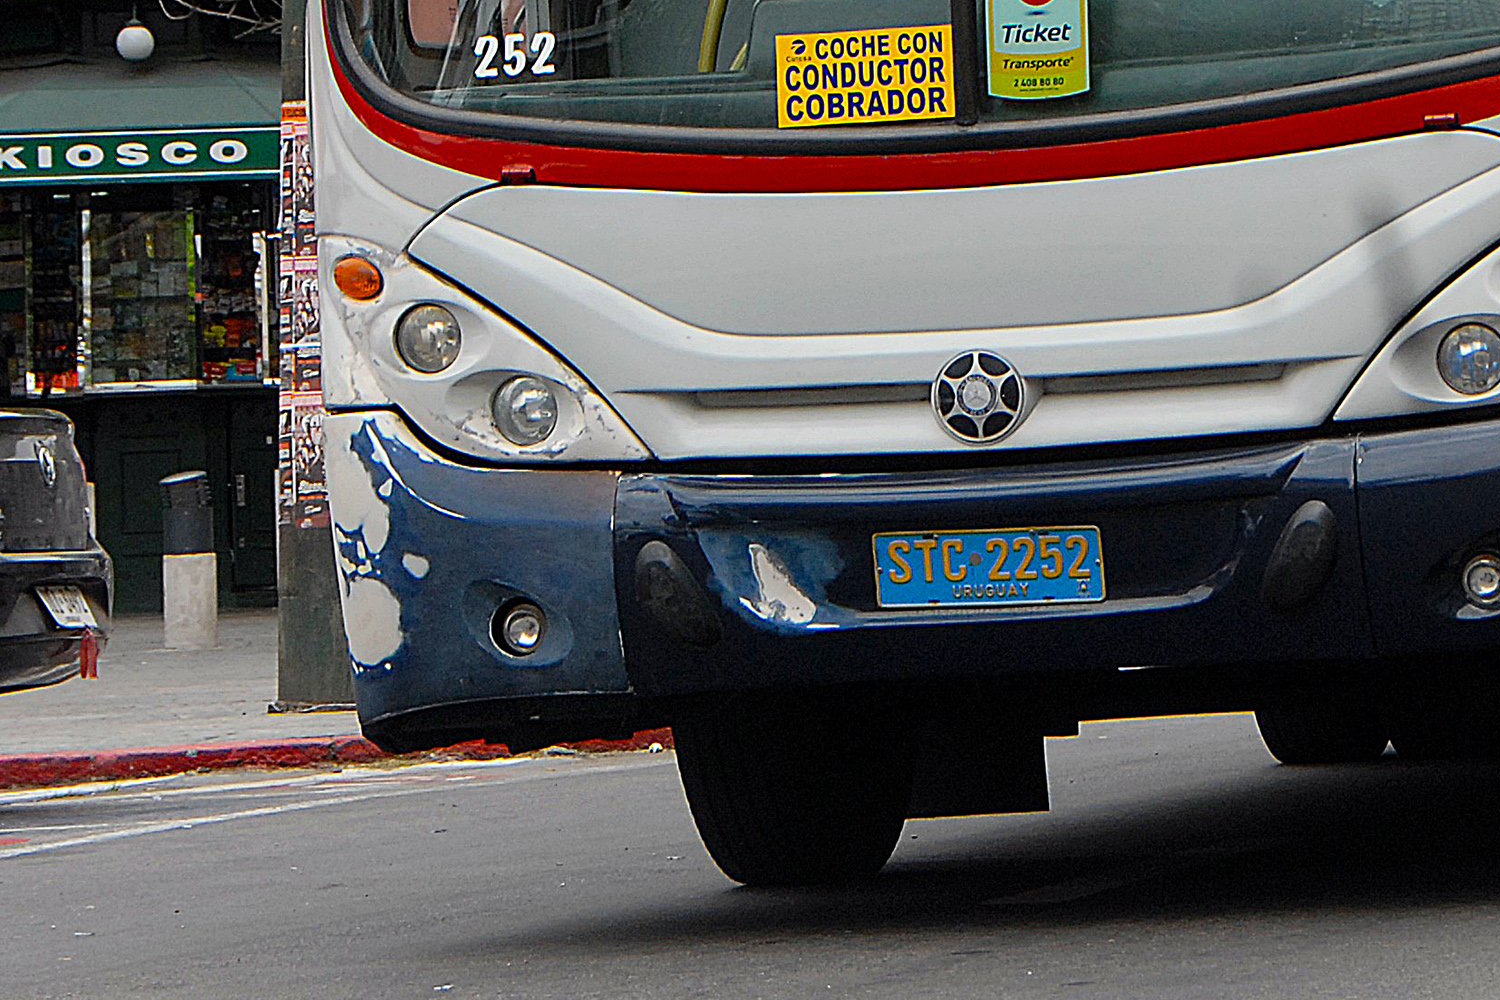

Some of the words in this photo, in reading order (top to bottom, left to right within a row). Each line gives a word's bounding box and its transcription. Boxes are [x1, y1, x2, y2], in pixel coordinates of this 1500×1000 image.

[815, 34, 890, 60] COCHE
[898, 31, 943, 55] CON
[1002, 22, 1072, 43] Ticket
[475, 31, 556, 79] 252
[785, 56, 945, 91] CONDUCTOR
[786, 87, 947, 121] COBRADOR
[0, 139, 248, 170] KIOSCO
[888, 539, 967, 583] STC
[986, 535, 1091, 580] 2252
[952, 582, 1029, 598] URUGUAY
